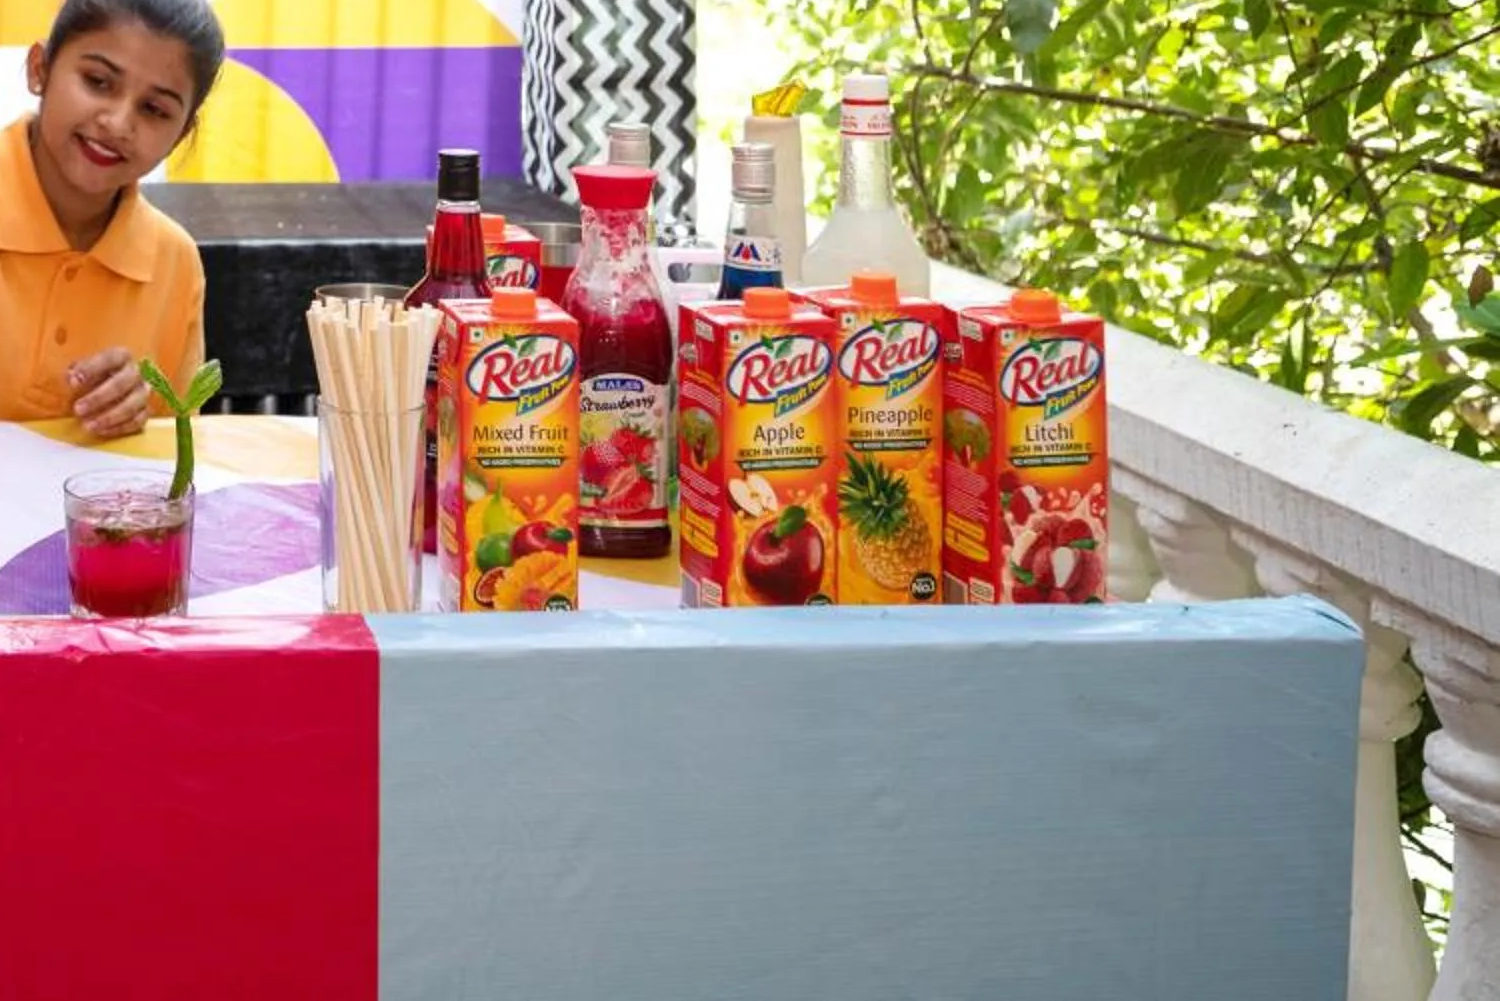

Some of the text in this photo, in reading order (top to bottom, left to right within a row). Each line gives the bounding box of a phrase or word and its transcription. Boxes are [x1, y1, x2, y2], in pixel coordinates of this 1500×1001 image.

[487, 257, 531, 288] eal
[851, 323, 930, 388] Real
[480, 340, 564, 405] Real
[739, 341, 819, 407] Real
[1010, 343, 1089, 409] Real
[518, 386, 549, 413] Fruit
[581, 394, 656, 412] Strawberry
[775, 387, 807, 415] Fruit
[847, 405, 933, 427] Pineapple
[473, 423, 569, 441] Mixed Fruit
[754, 422, 805, 446] Apple
[1025, 422, 1074, 442] Litchi
[516, 445, 555, 454] VITAMIN
[775, 446, 813, 456] VITAMIN
